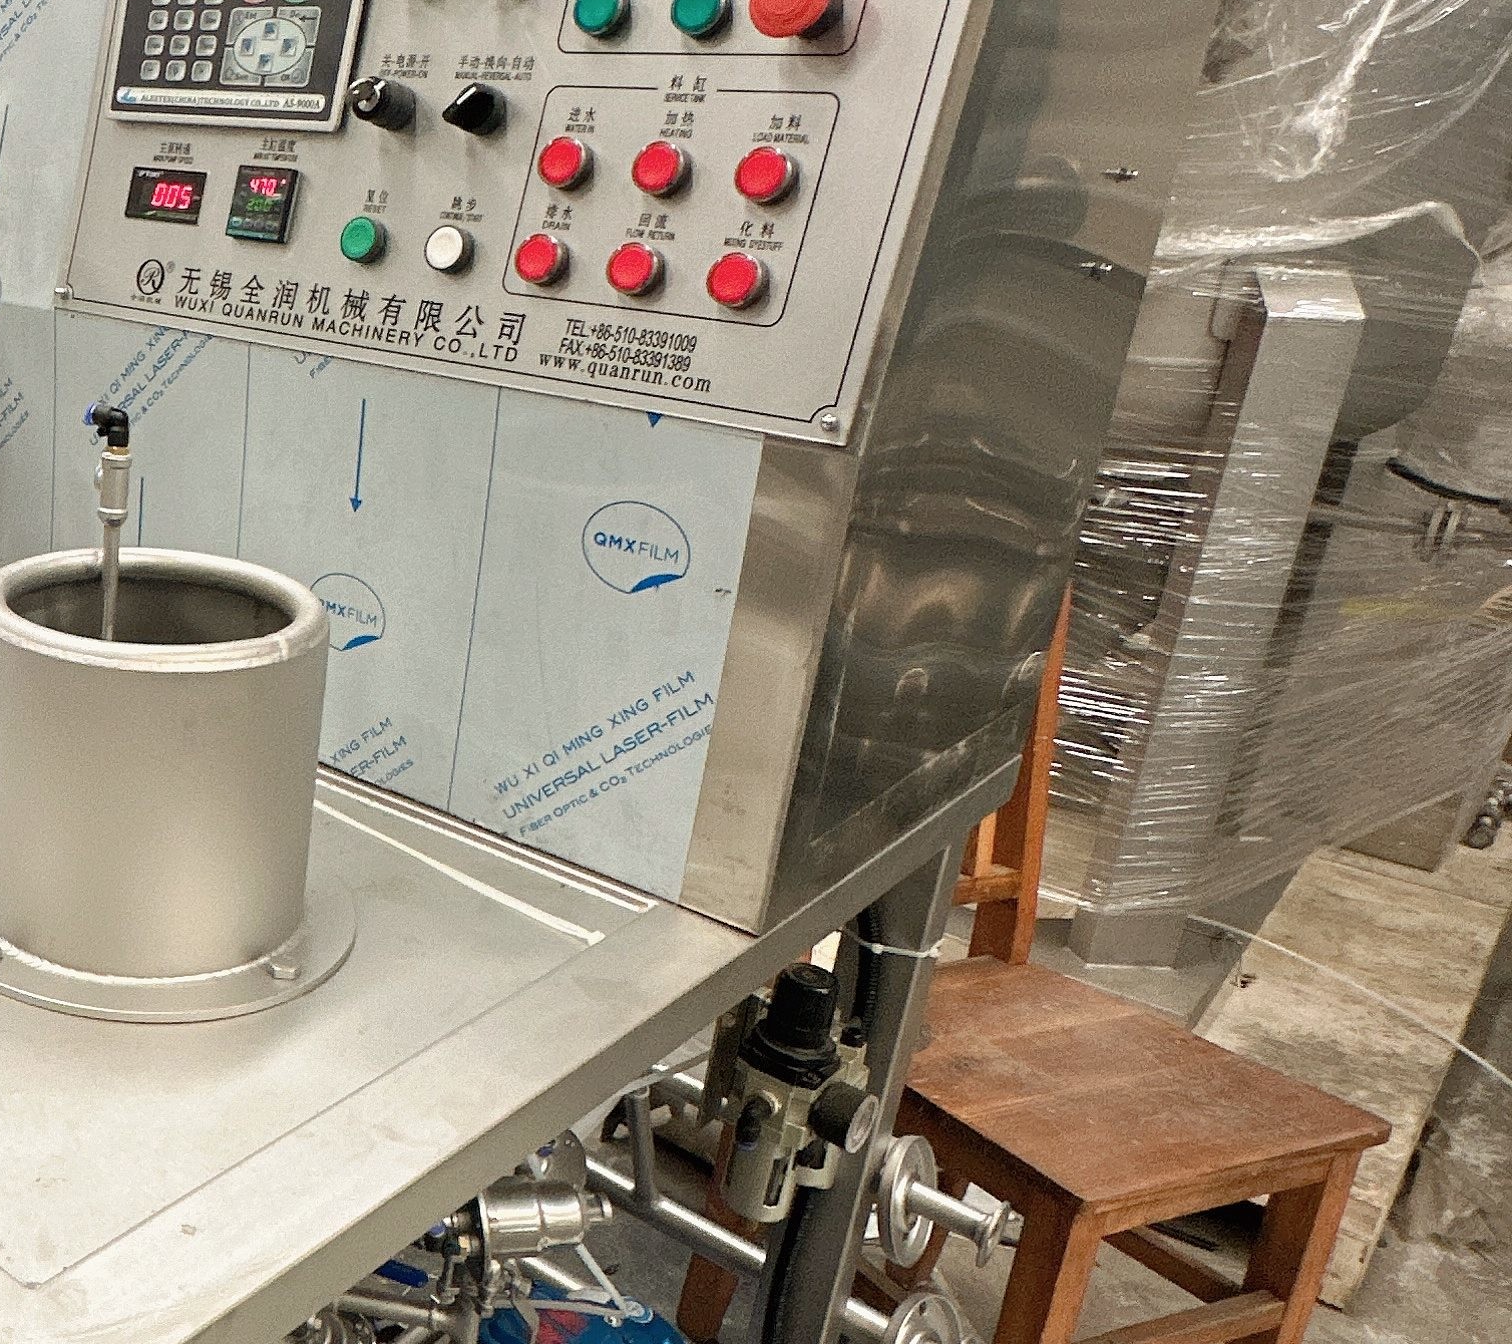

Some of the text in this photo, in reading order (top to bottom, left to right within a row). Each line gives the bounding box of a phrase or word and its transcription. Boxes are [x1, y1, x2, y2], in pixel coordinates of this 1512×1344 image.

[770, 114, 803, 131] 加料
[738, 220, 776, 238] 化料
[174, 294, 214, 313] WUXI
[221, 302, 304, 329] QUANRUN
[312, 317, 423, 347] MACHINERY
[177, 267, 526, 346] 无锡全润机械有限公司
[120, 350, 147, 382] MING
[539, 353, 711, 393] www.quanrun.com
[593, 531, 679, 564] QMXFILM
[360, 716, 394, 744] FILM
[494, 670, 696, 797] WU XI QI MING XING FILM
[502, 692, 715, 820] UNIVERSAL LASER-FILM
[519, 813, 554, 838] FIBER
[553, 794, 590, 818] OPTIC
[589, 788, 600, 799] &
